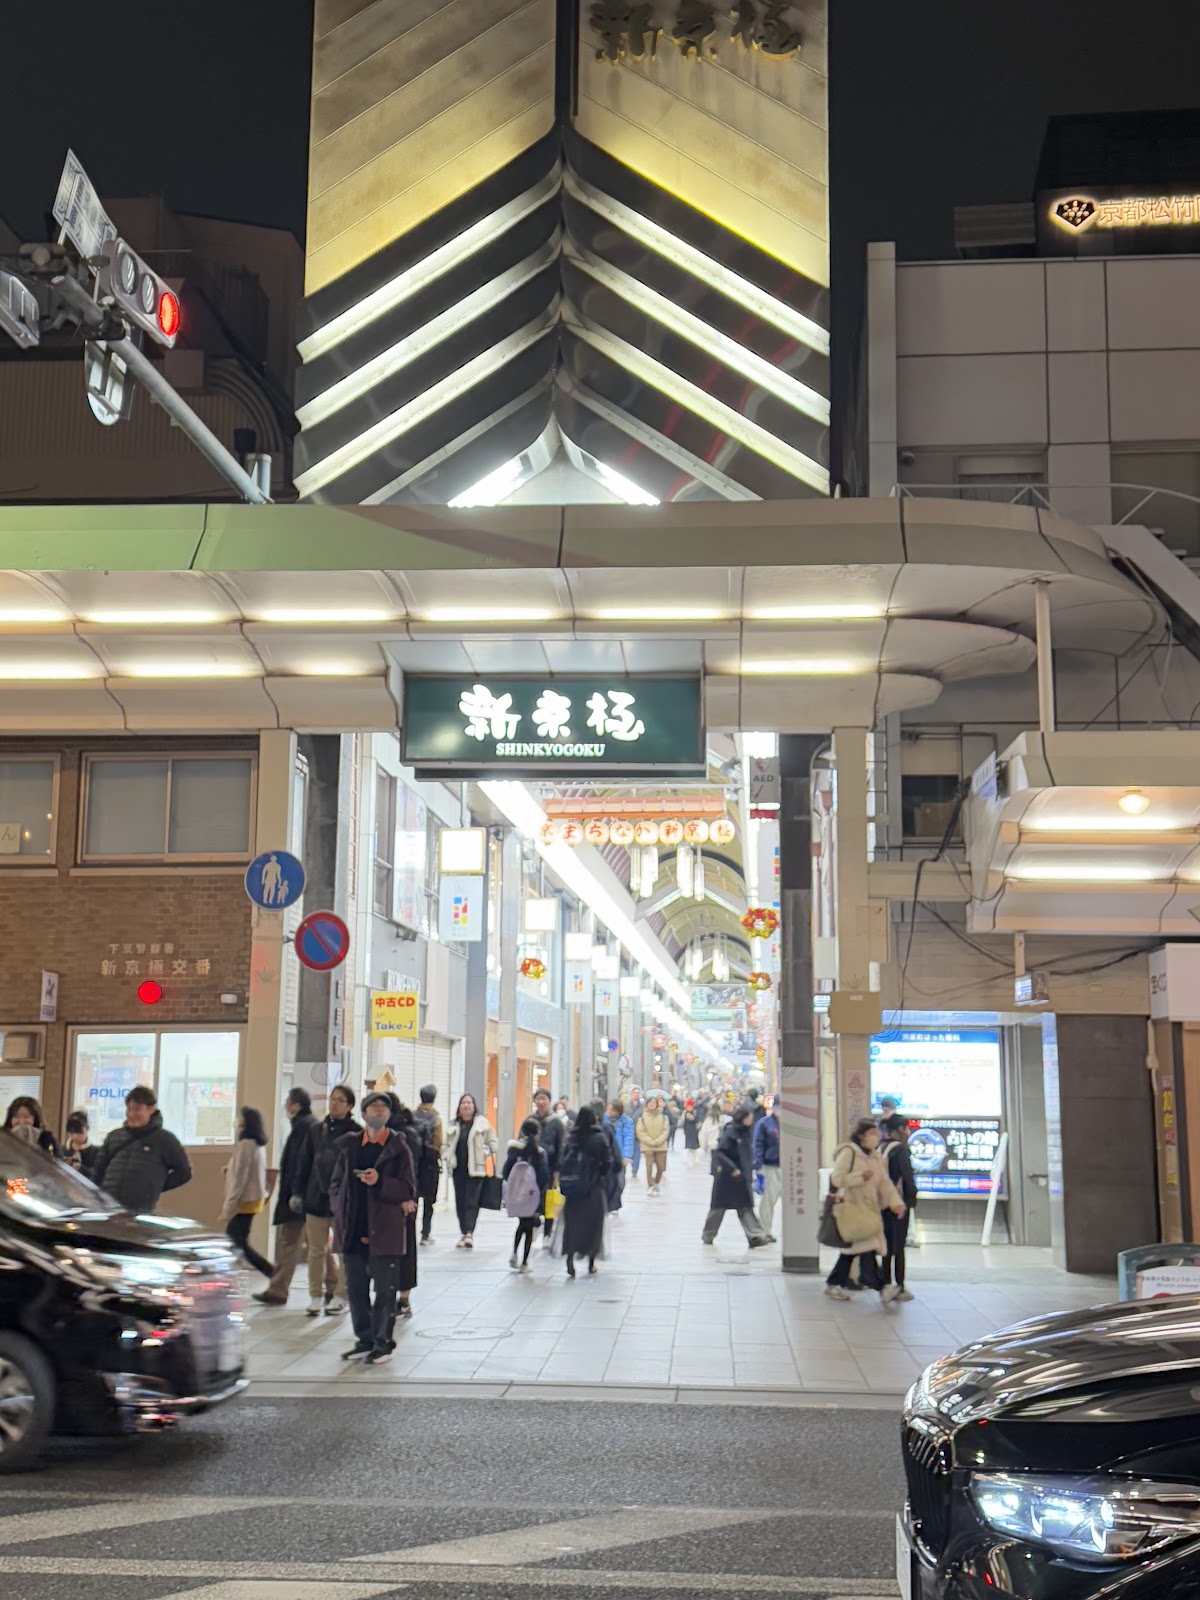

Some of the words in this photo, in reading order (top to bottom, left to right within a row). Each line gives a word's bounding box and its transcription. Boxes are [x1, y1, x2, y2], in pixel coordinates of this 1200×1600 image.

[458, 683, 646, 741] 新京極
[495, 742, 606, 758] SHINKYOGOKU
[753, 774, 774, 782] AED
[101, 958, 211, 976] 新京極交番
[375, 996, 416, 1008] 中古CD
[375, 1020, 413, 1031] Take-J
[89, 1087, 131, 1098] POLIC
